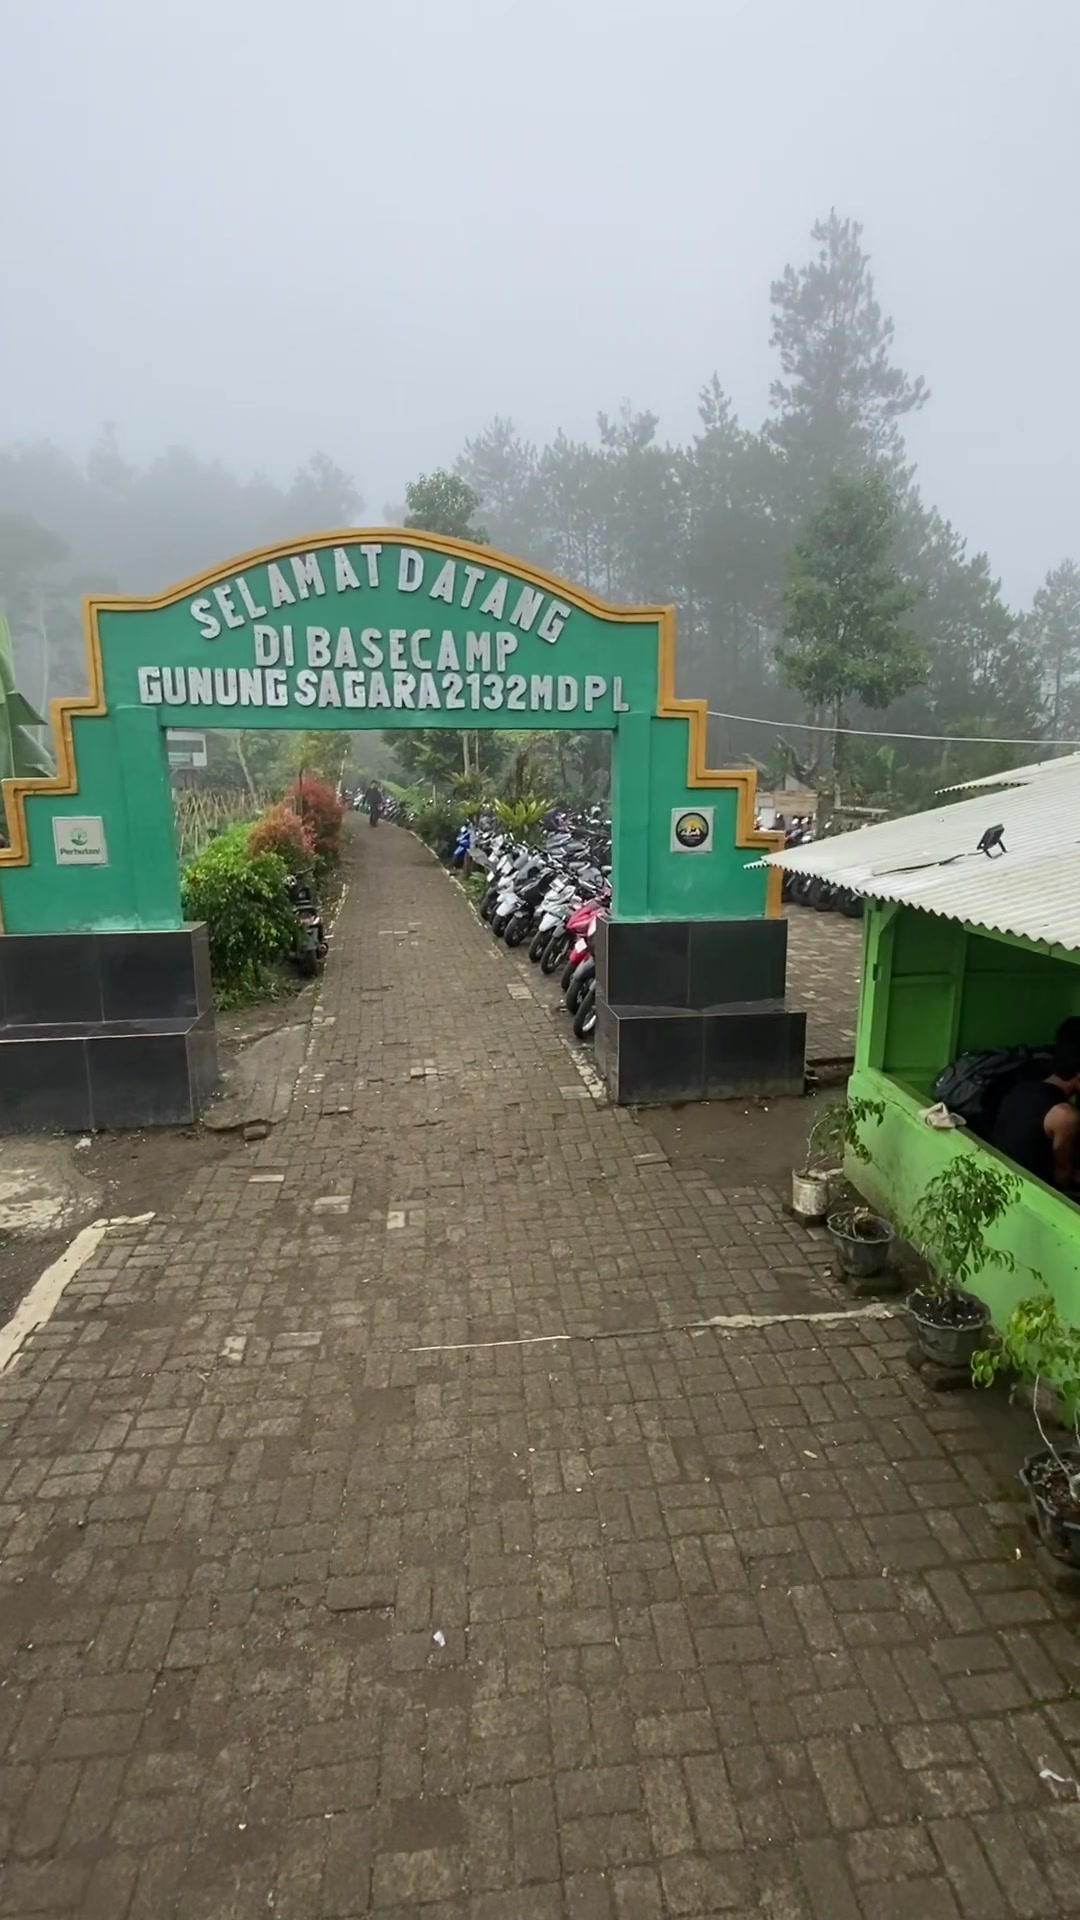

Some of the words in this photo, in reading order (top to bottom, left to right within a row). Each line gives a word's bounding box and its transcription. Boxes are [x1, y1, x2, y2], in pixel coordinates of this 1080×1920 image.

[190, 544, 382, 639] SELAMAT
[397, 548, 572, 644] DATANG
[253, 624, 295, 667] DI
[306, 625, 518, 672] BASECAMP
[137, 666, 289, 707] GUNUNG
